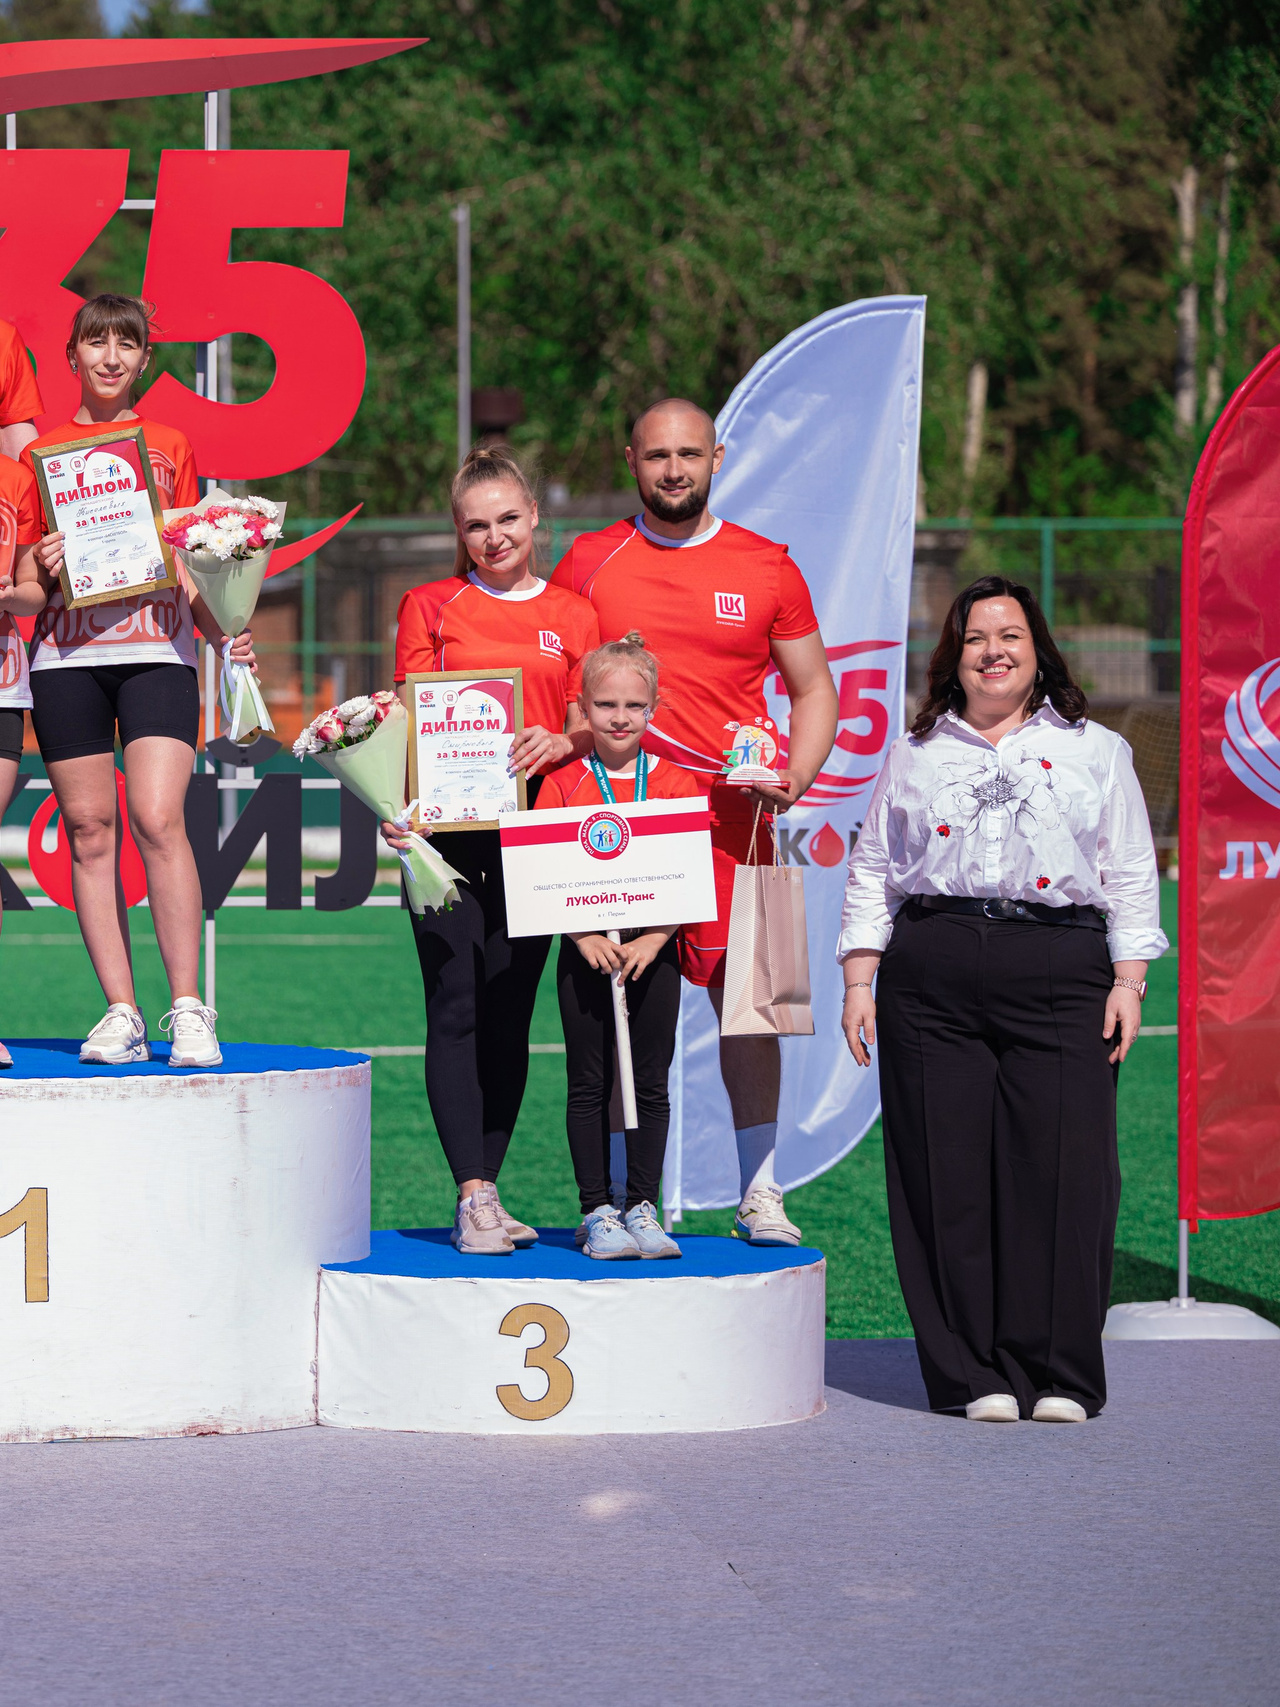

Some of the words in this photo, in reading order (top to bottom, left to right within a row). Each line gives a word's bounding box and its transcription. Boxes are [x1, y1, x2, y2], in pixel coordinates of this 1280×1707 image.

[55, 477, 132, 506] ДИПЛОМ
[76, 520, 87, 528] за
[90, 516, 96, 525] 1
[100, 510, 132, 522] место
[420, 719, 500, 735] ДИПЛОМ
[452, 750, 458, 758] 3
[462, 750, 495, 758] место
[582, 821, 592, 838] МАМА,
[599, 813, 628, 834] СПОРТИВНАЯ
[583, 839, 594, 855] ПАПА,
[533, 883, 567, 891] ОБЩЕСТВО
[574, 877, 623, 888] ОГРАНИЧЕННОЙ
[623, 873, 685, 884] ОТВЕТСТВЕННОСТЬЮ
[565, 891, 655, 907] ЛУКОЙЛ-Транс
[496, 1303, 574, 1421] 3
